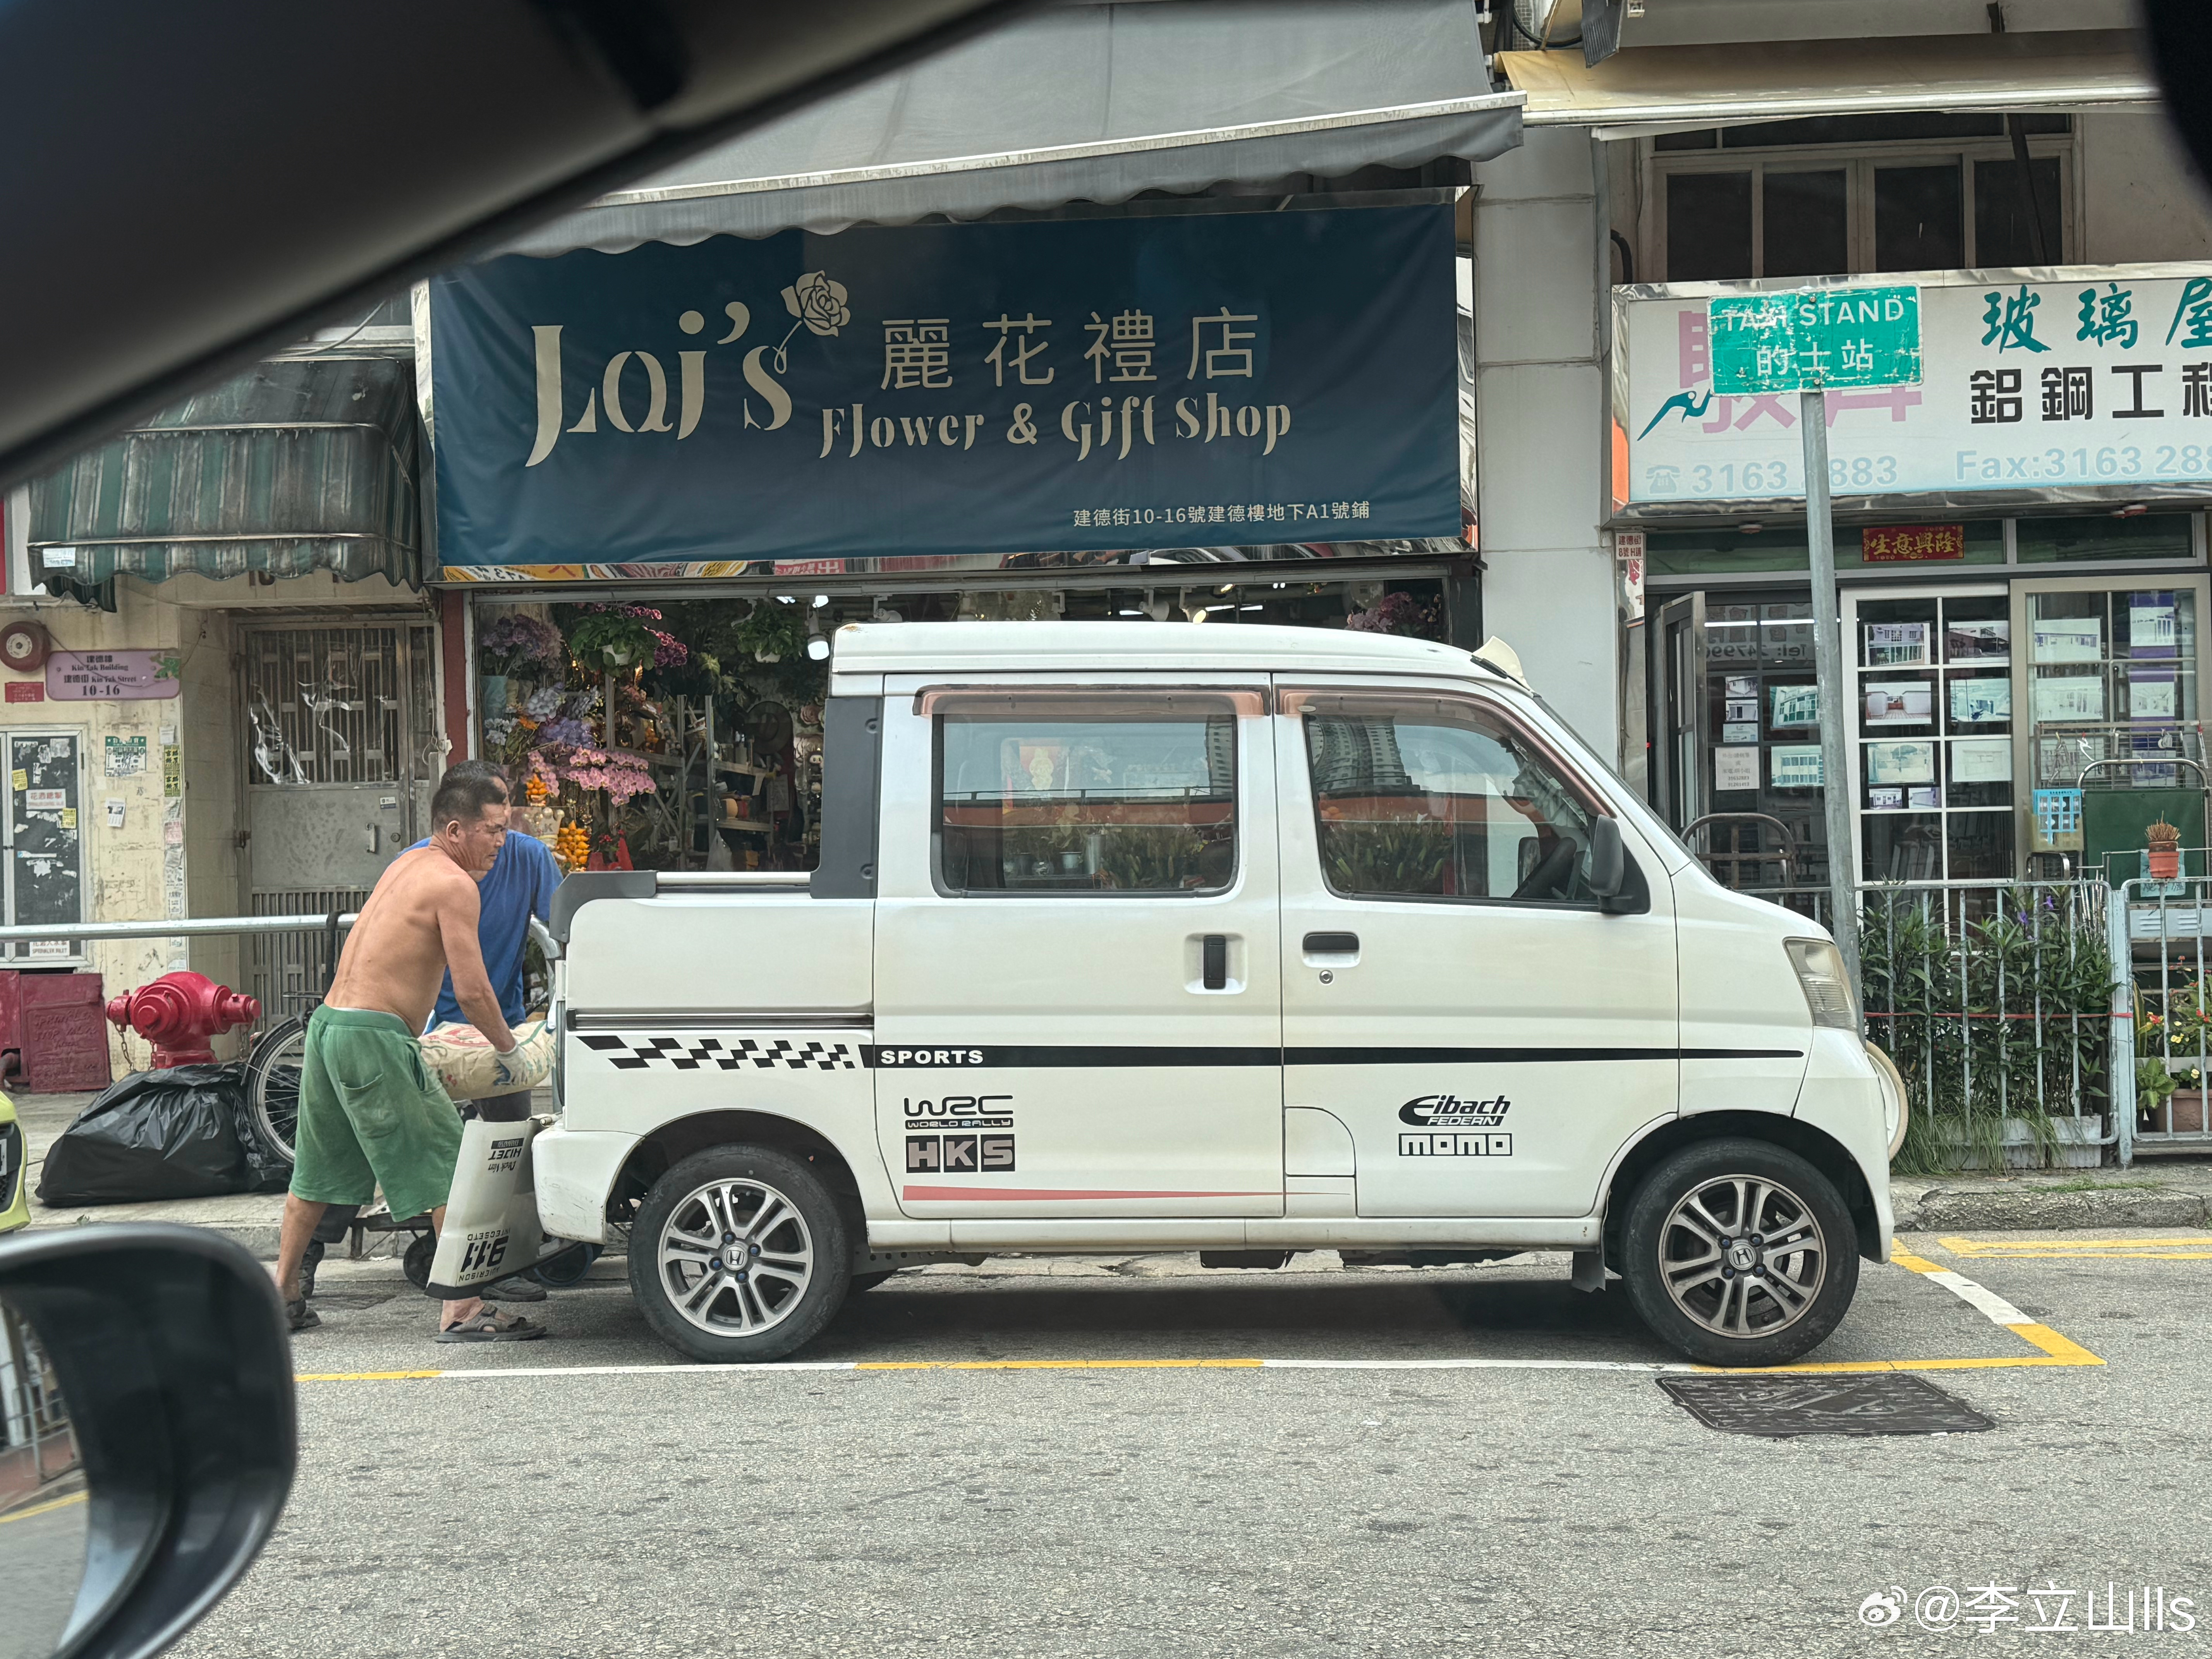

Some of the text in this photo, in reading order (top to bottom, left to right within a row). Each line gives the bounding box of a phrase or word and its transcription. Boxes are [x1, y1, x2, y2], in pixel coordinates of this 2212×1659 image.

[1800, 299, 1903, 326] STAND
[881, 306, 1258, 390] 麗花禮店
[1757, 338, 1873, 376] 的士站
[819, 392, 1291, 461] Flower & Gift Shop
[1691, 455, 1897, 494] 3163 883
[1956, 445, 2212, 481] Fax:3163 28
[1073, 501, 1370, 527] 建德街10-16號建德樓地下A1號鋪
[1619, 535, 1641, 545] 建德街
[1870, 531, 1956, 555] 生意興隆
[82, 684, 120, 696] 10-16
[881, 1050, 983, 1064] SPORTS
[904, 1095, 1013, 1116] WRC
[1398, 1095, 1511, 1126] Eibach
[1427, 1116, 1498, 1125] FEDERN
[488, 1148, 522, 1160] HIJET
[908, 1139, 1013, 1168] HKS
